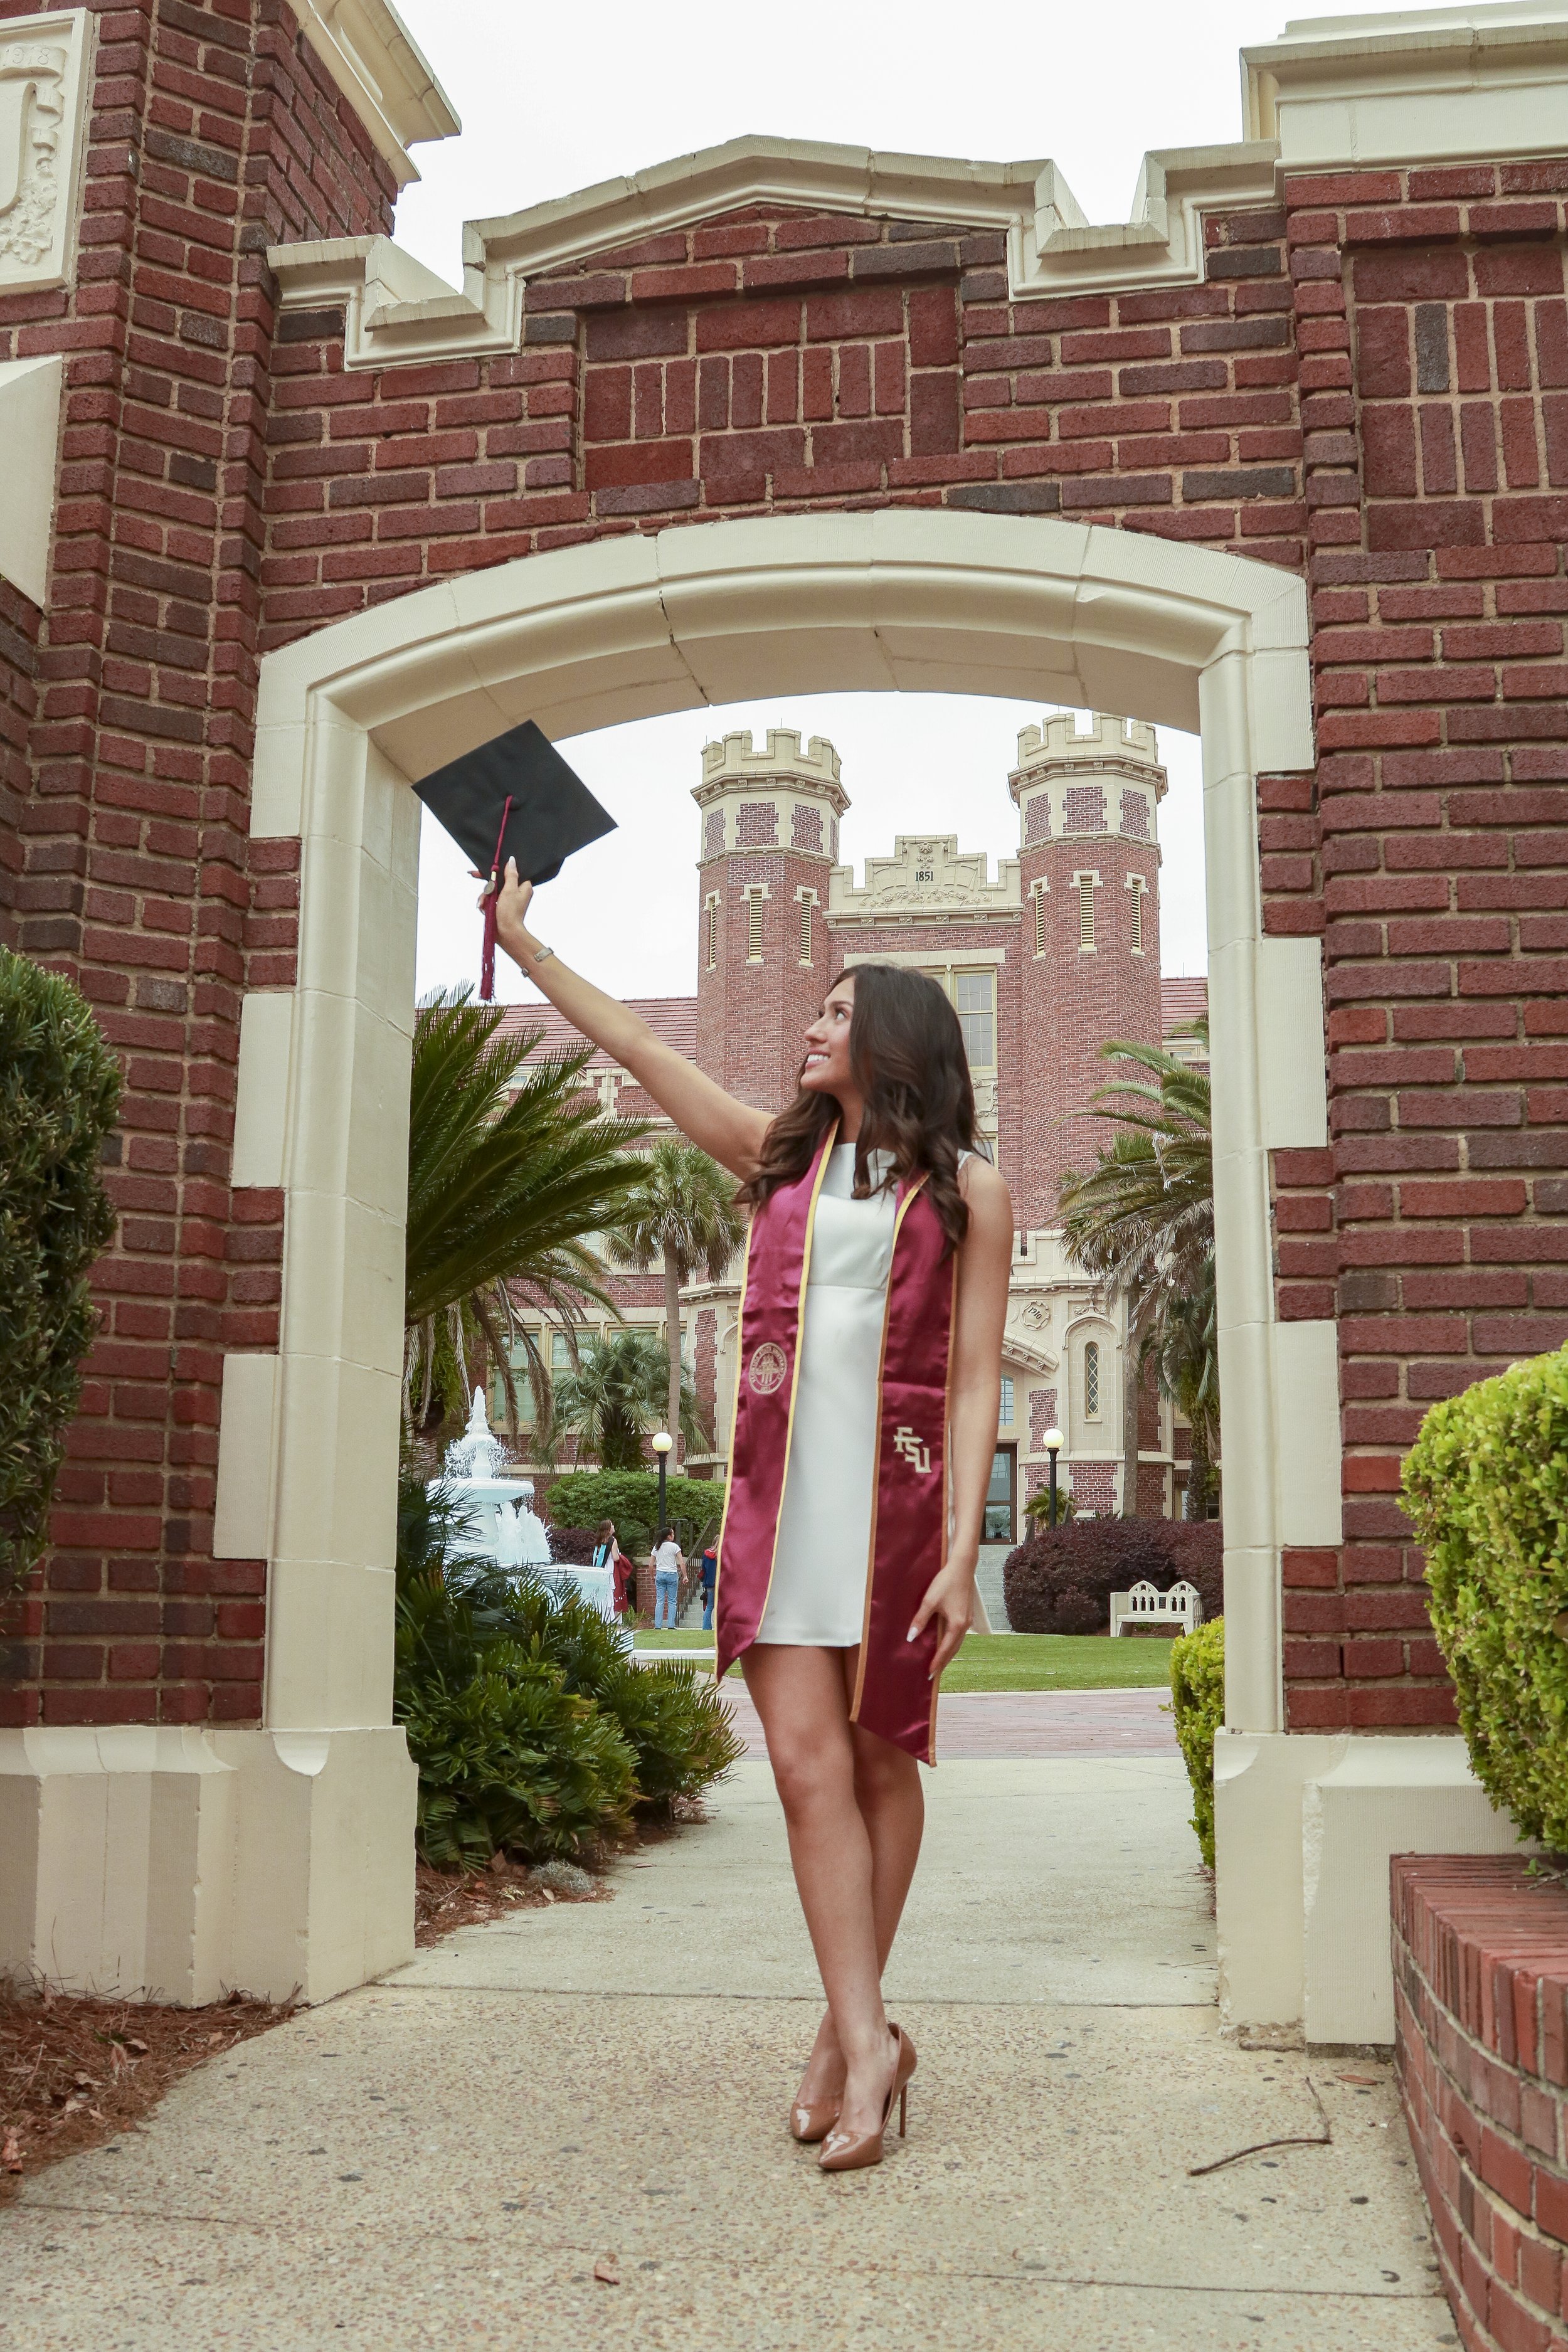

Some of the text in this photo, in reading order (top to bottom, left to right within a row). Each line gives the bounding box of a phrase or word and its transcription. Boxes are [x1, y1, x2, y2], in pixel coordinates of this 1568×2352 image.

[915, 871, 934, 882] 1851
[1027, 1306, 1042, 1320] 1910
[893, 1426, 932, 1473] FSU
